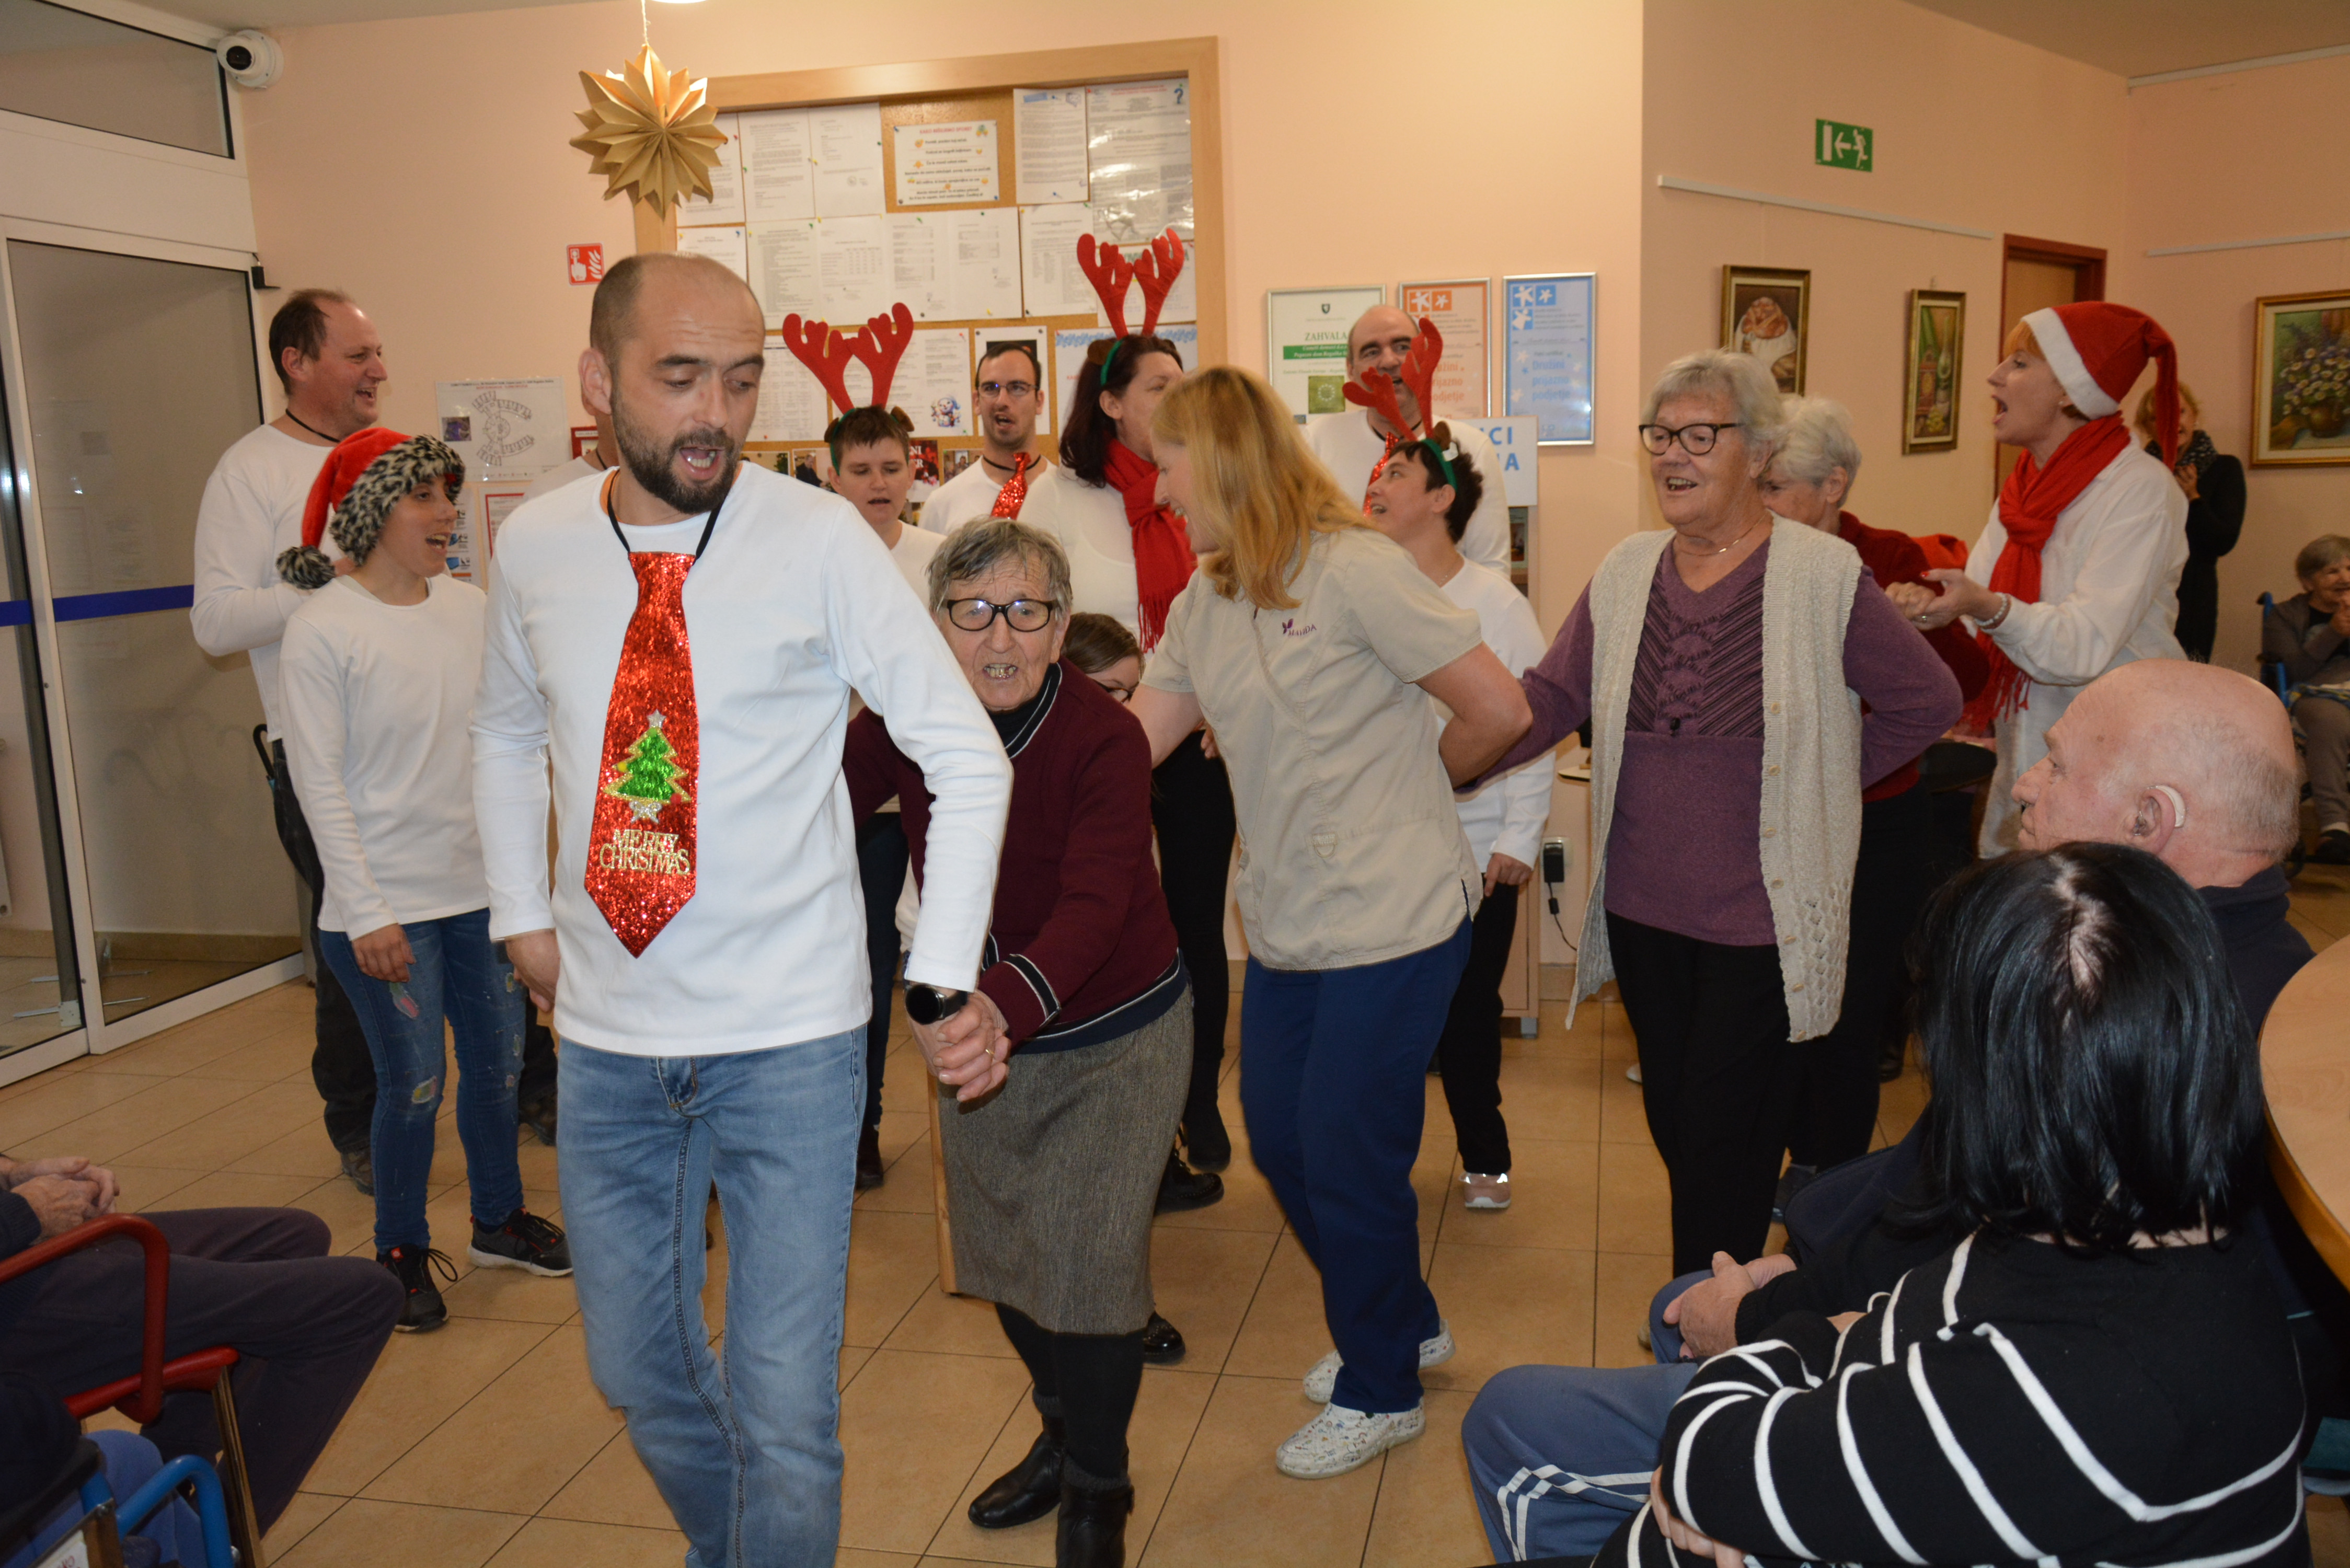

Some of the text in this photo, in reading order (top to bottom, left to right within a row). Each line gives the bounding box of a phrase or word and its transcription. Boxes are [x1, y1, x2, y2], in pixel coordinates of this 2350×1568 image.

[1305, 331, 1347, 341] ZAHVALA
[1532, 359, 1565, 371] Družini
[1532, 374, 1571, 388] prijazno
[1532, 389, 1571, 402] podjetje
[613, 829, 679, 855] MERRY
[600, 843, 690, 875] CHRISTMAS
